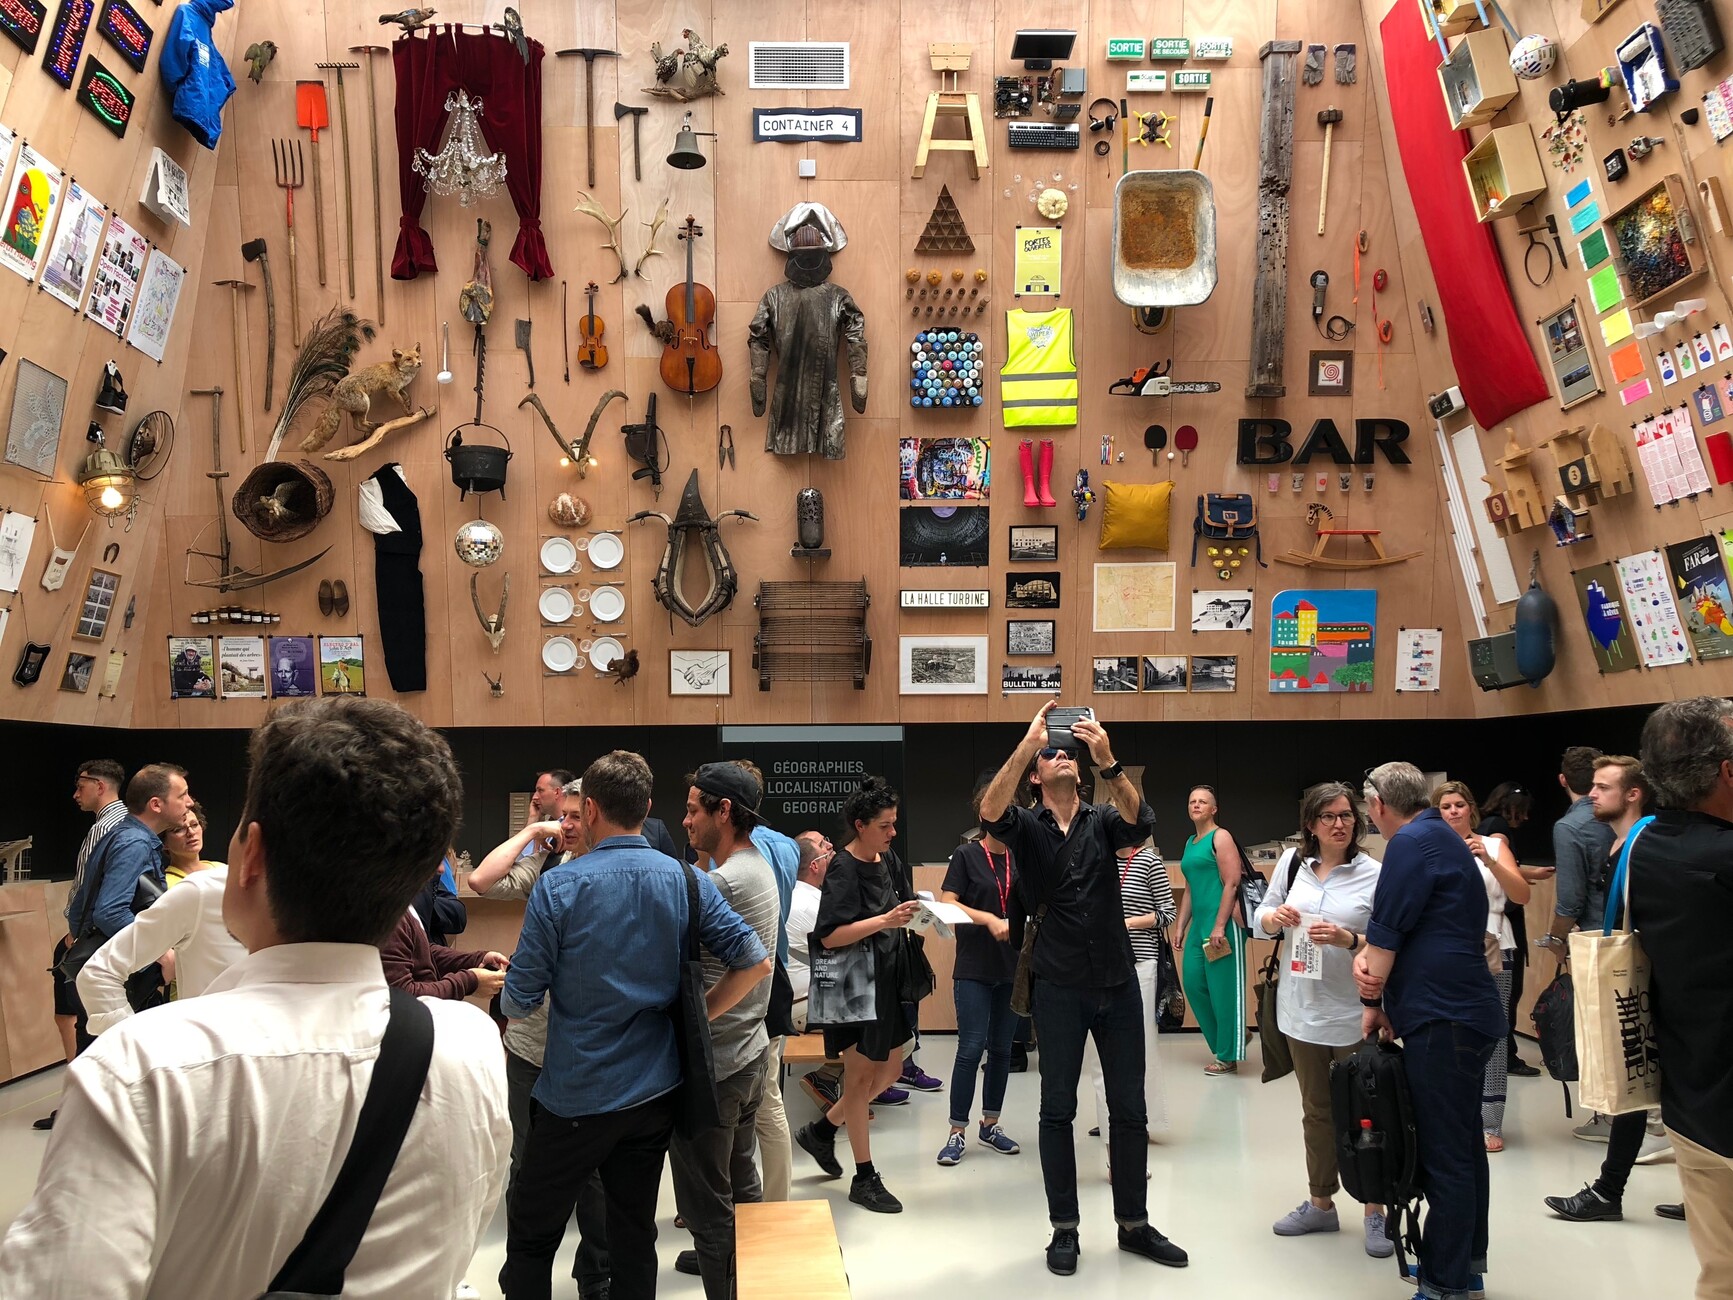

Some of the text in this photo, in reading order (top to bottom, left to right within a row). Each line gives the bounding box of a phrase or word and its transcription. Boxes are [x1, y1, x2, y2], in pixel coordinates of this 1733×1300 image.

[1110, 42, 1143, 52] SORTIE
[1156, 40, 1187, 48] SORTIE
[1201, 42, 1228, 50] SORTIE
[1179, 73, 1207, 83] SORTIE
[763, 119, 849, 132] CONTAINER 4
[1024, 236, 1051, 248] PORTES
[99, 257, 131, 288] Open Factory
[1237, 418, 1412, 464] BAR
[1684, 552, 1701, 572] FAR
[904, 593, 985, 605] LA HALLE TURBINE
[773, 760, 864, 774] GÉOGRAPHIES
[767, 781, 861, 794] LOCALISATION
[782, 801, 844, 814] GEOGRAF
